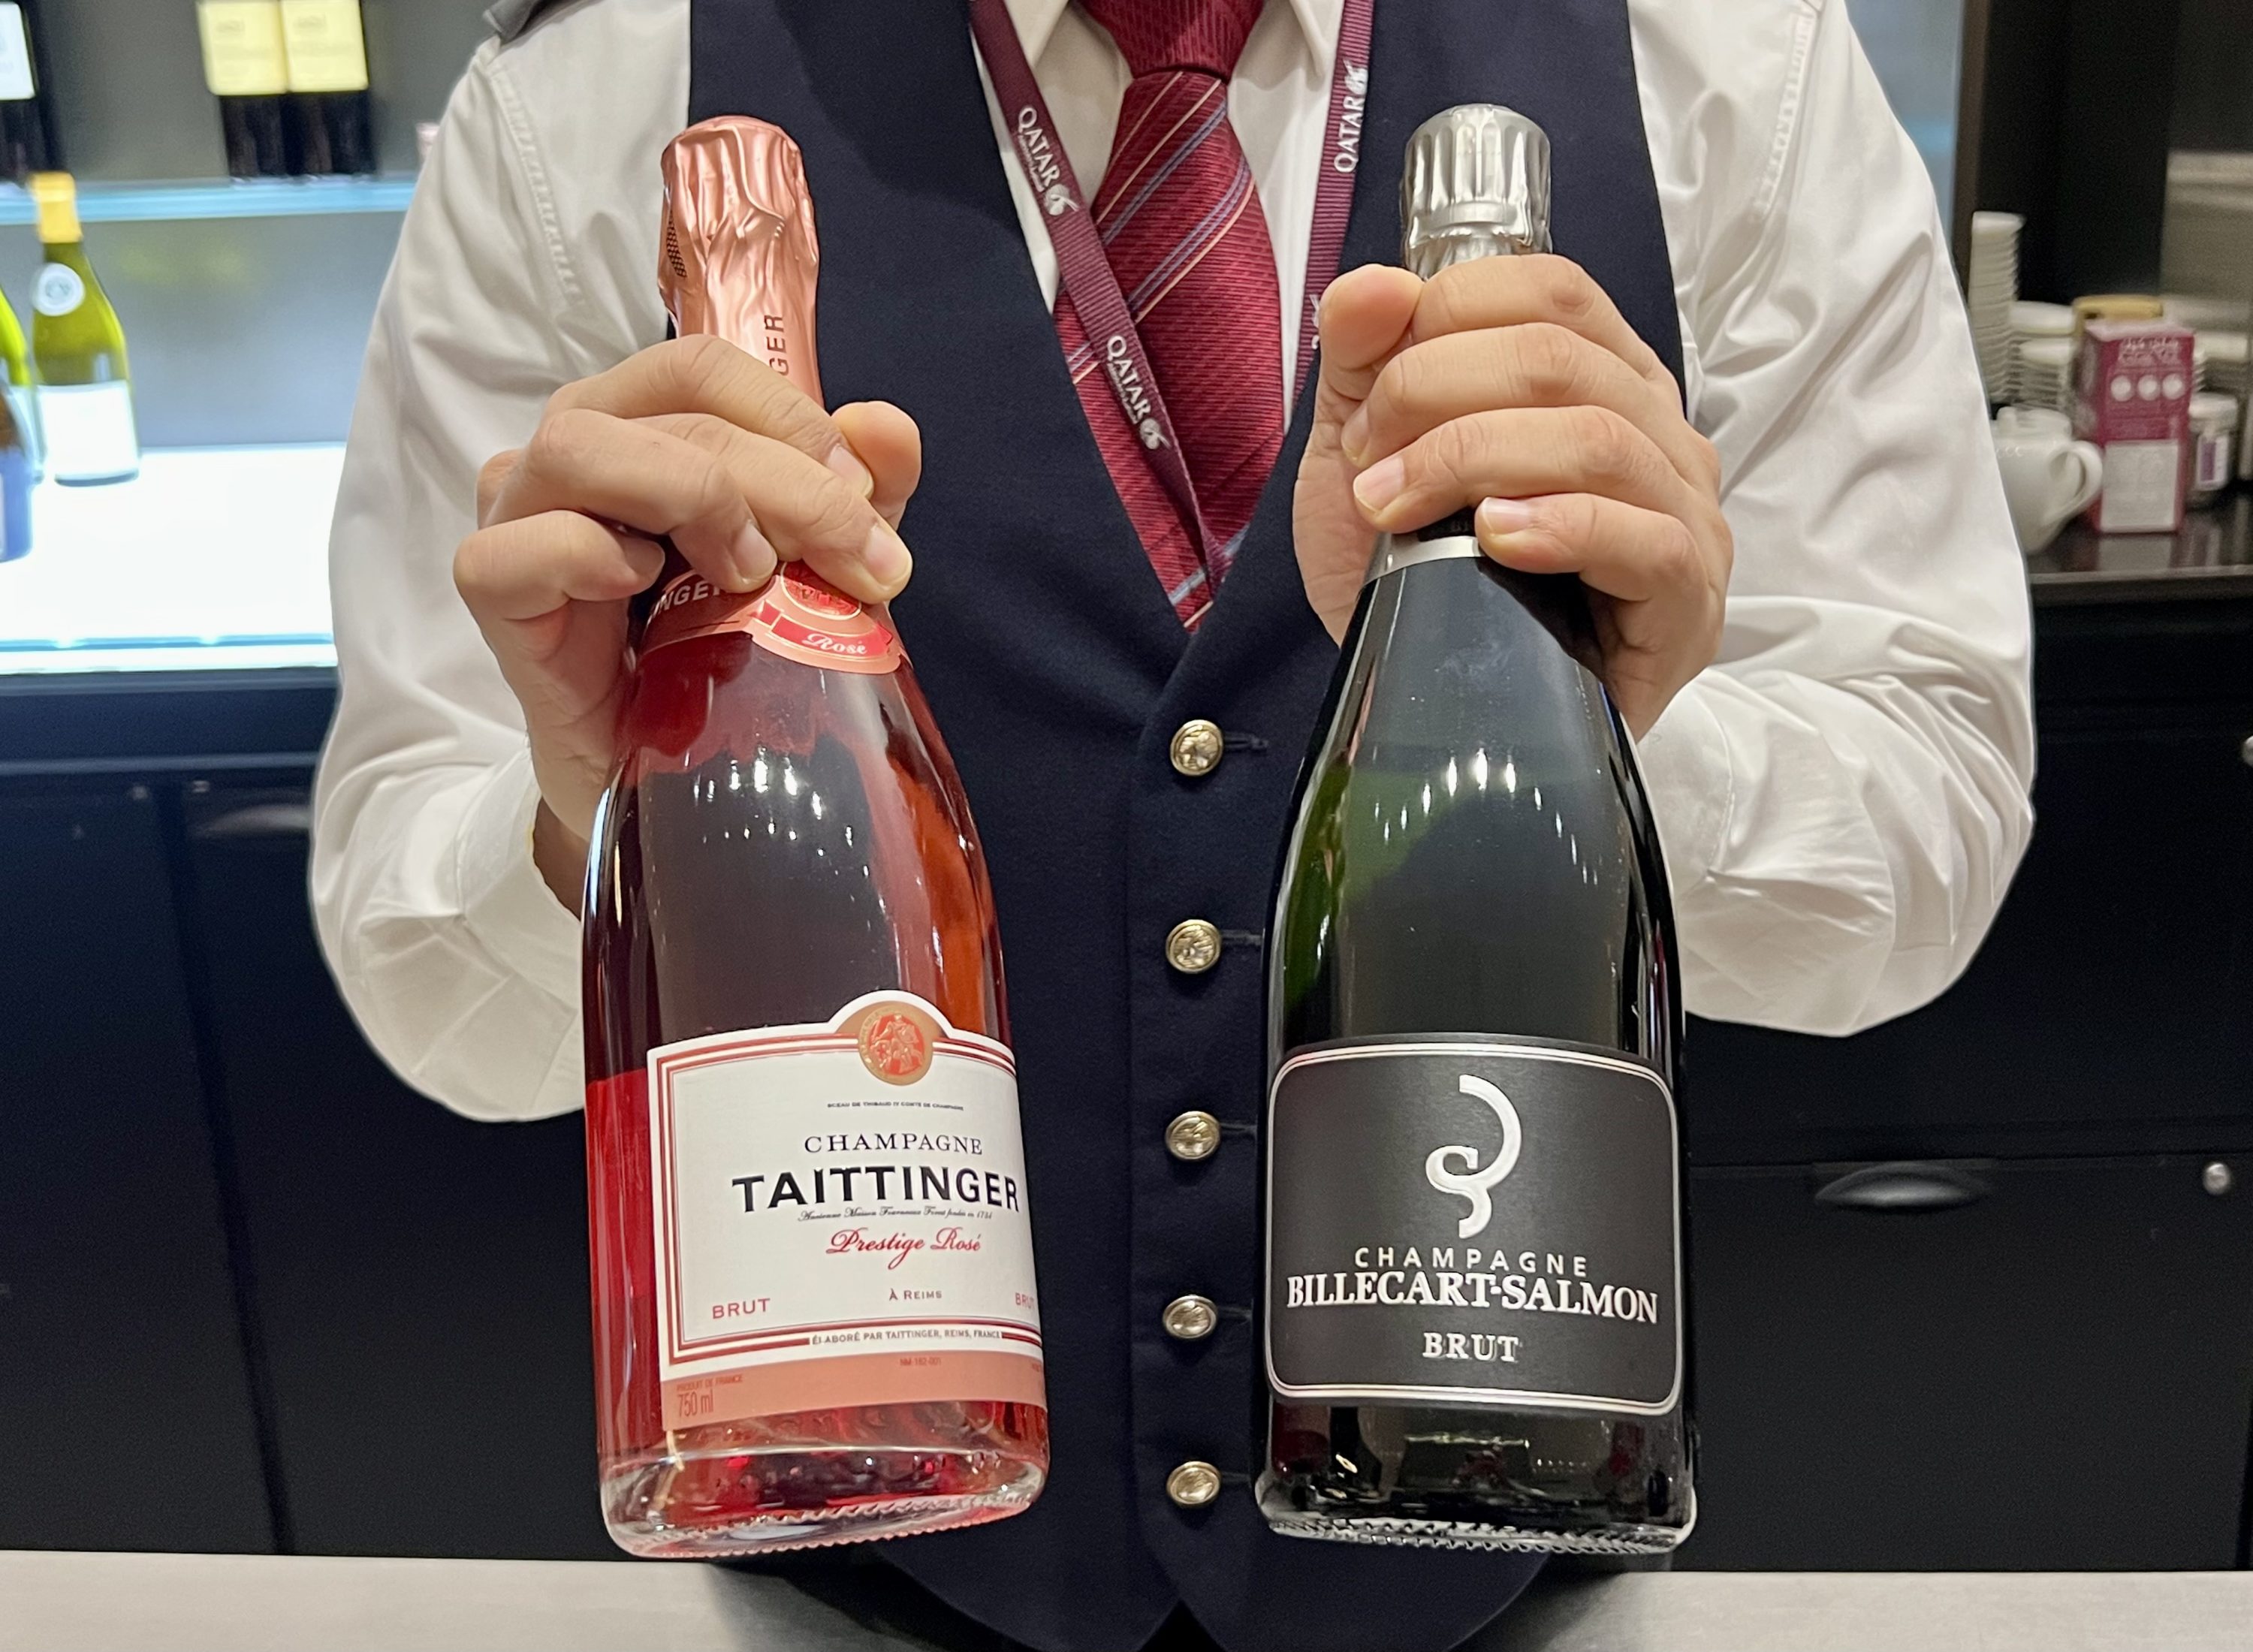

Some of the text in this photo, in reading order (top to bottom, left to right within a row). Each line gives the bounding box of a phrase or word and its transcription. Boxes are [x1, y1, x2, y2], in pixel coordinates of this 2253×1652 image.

[1018, 106, 1060, 188] QATAR
[1334, 95, 1365, 173] QATAR
[764, 315, 789, 376] GER
[1107, 335, 1151, 421] QATAR
[804, 1133, 982, 1156] CHAMPAGNE
[731, 1165, 1020, 1211] TAITTINGER
[825, 1227, 981, 1271] Prestige Rosé
[1355, 1247, 1587, 1277] CHAMPAGNE
[712, 1298, 771, 1319] BRUT
[888, 1288, 942, 1301] À REIMS
[1286, 1271, 1658, 1324] BILLECART-SALMON
[863, 1331, 883, 1341] PAR
[885, 1328, 943, 1340] TAITTINGER,
[1422, 1332, 1522, 1363] BRUT
[678, 1388, 714, 1418] 750 ml
